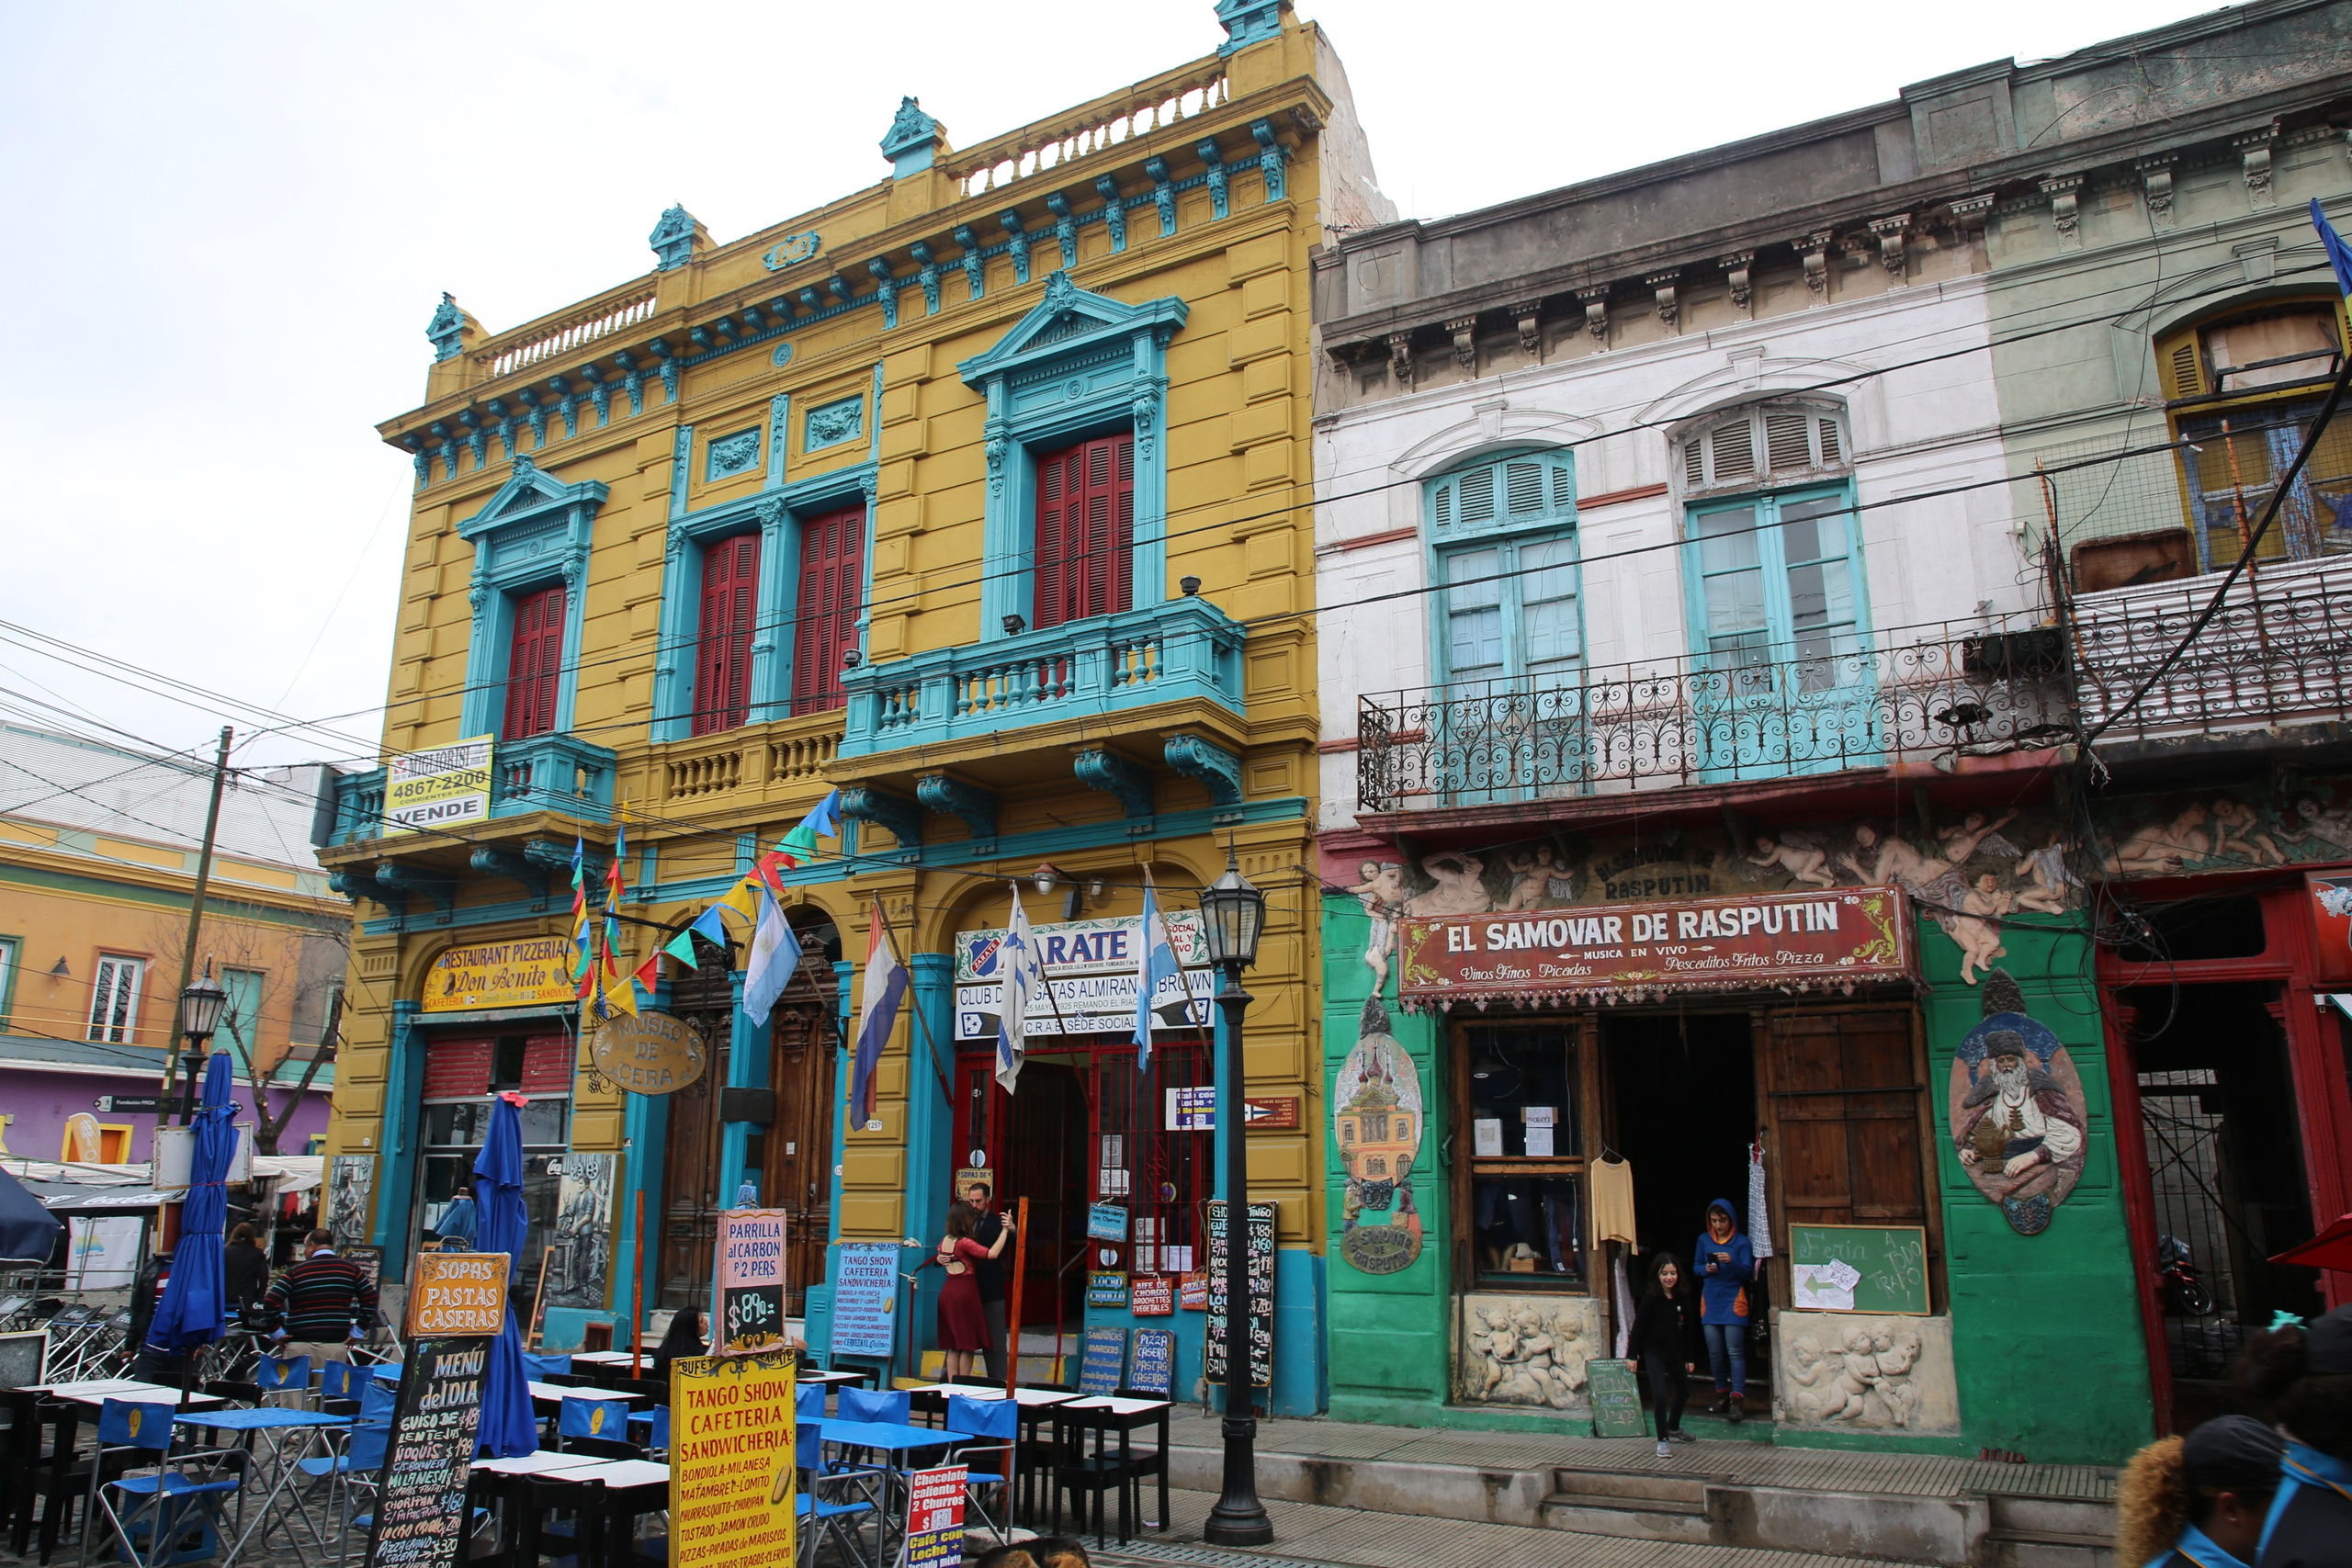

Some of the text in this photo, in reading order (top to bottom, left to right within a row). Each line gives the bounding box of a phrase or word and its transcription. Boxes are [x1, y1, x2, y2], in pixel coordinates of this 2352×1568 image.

[393, 771, 486, 798] 4867-2200
[400, 792, 453, 806] CORRIENTES
[396, 799, 478, 824] VENDE
[1605, 874, 1711, 899] RASPUTIN
[1448, 901, 1839, 953] EL SAMOVAR DE RASPUTIN
[444, 940, 566, 970] RESTAURANT PIZZERIA
[973, 941, 998, 970] ZARATE
[1583, 945, 1688, 960] MUSICA EN VIVO
[1664, 950, 1824, 972] Pescaditos Fritos Pizza
[455, 964, 547, 993] Don Benito
[1460, 963, 1592, 981] Vinos Finos Picadas
[428, 988, 575, 1008] CAFETERIA SANDWICH
[960, 987, 991, 1005] CLUB
[996, 987, 1002, 1003] D
[1030, 982, 1076, 1001] GATAS
[1079, 977, 1139, 998] ALMIRAN
[1035, 1003, 1054, 1011] MAYO
[1073, 999, 1109, 1010] REMANDO
[1110, 998, 1119, 1008] EL
[616, 1017, 683, 1043] MUSEO
[1067, 1017, 1137, 1032] SEDE SOCIAL
[635, 1041, 659, 1060] DE
[616, 1062, 673, 1088] CERA
[729, 1223, 781, 1241] PARRILLA
[1374, 1246, 1385, 1254] DE
[1798, 1232, 1869, 1260] Feria
[752, 1259, 778, 1280] PERS.
[844, 1256, 894, 1266] TANGO SHOW
[1352, 1249, 1411, 1270] RASPUTIN
[434, 1261, 492, 1282] SOPAS
[844, 1267, 889, 1278] CAFETERIA
[1135, 1289, 1170, 1297] CHORIZO
[1136, 1280, 1168, 1290] BIFE DE
[423, 1286, 499, 1309] PASTAS
[1133, 1296, 1171, 1304] BROCHETTES
[420, 1308, 500, 1331] CASERAS
[1140, 1334, 1168, 1346] PIZZA
[432, 1342, 486, 1379] MENÚ
[1136, 1347, 1168, 1360] CASERA
[1136, 1360, 1168, 1371] PASTAS
[1132, 1373, 1168, 1386] CASERAS
[686, 1379, 788, 1408] TANGO SHOW
[400, 1410, 438, 1431] GUISO
[439, 1411, 459, 1426] DE
[691, 1405, 783, 1435] CAFETERIA
[398, 1427, 462, 1443] LENTEJAS
[681, 1428, 792, 1462] SANDWICHERIA:
[387, 1469, 448, 1489] MILANESA
[682, 1457, 771, 1483] BONDIOLA-MILANESA
[914, 1470, 968, 1486] Chocolate
[681, 1481, 729, 1503] MATAMBRE
[912, 1483, 956, 1499] caliente
[912, 1495, 966, 1512] 2 Churros
[747, 1512, 770, 1529] CRUDO
[922, 1516, 930, 1529] $
[379, 1523, 413, 1541] LOCRO
[910, 1529, 964, 1549] Café con
[680, 1528, 786, 1563] PIZZAS-PICADAS de MARISCOS
[911, 1544, 948, 1562] Leche
[939, 1554, 962, 1567] mixto
